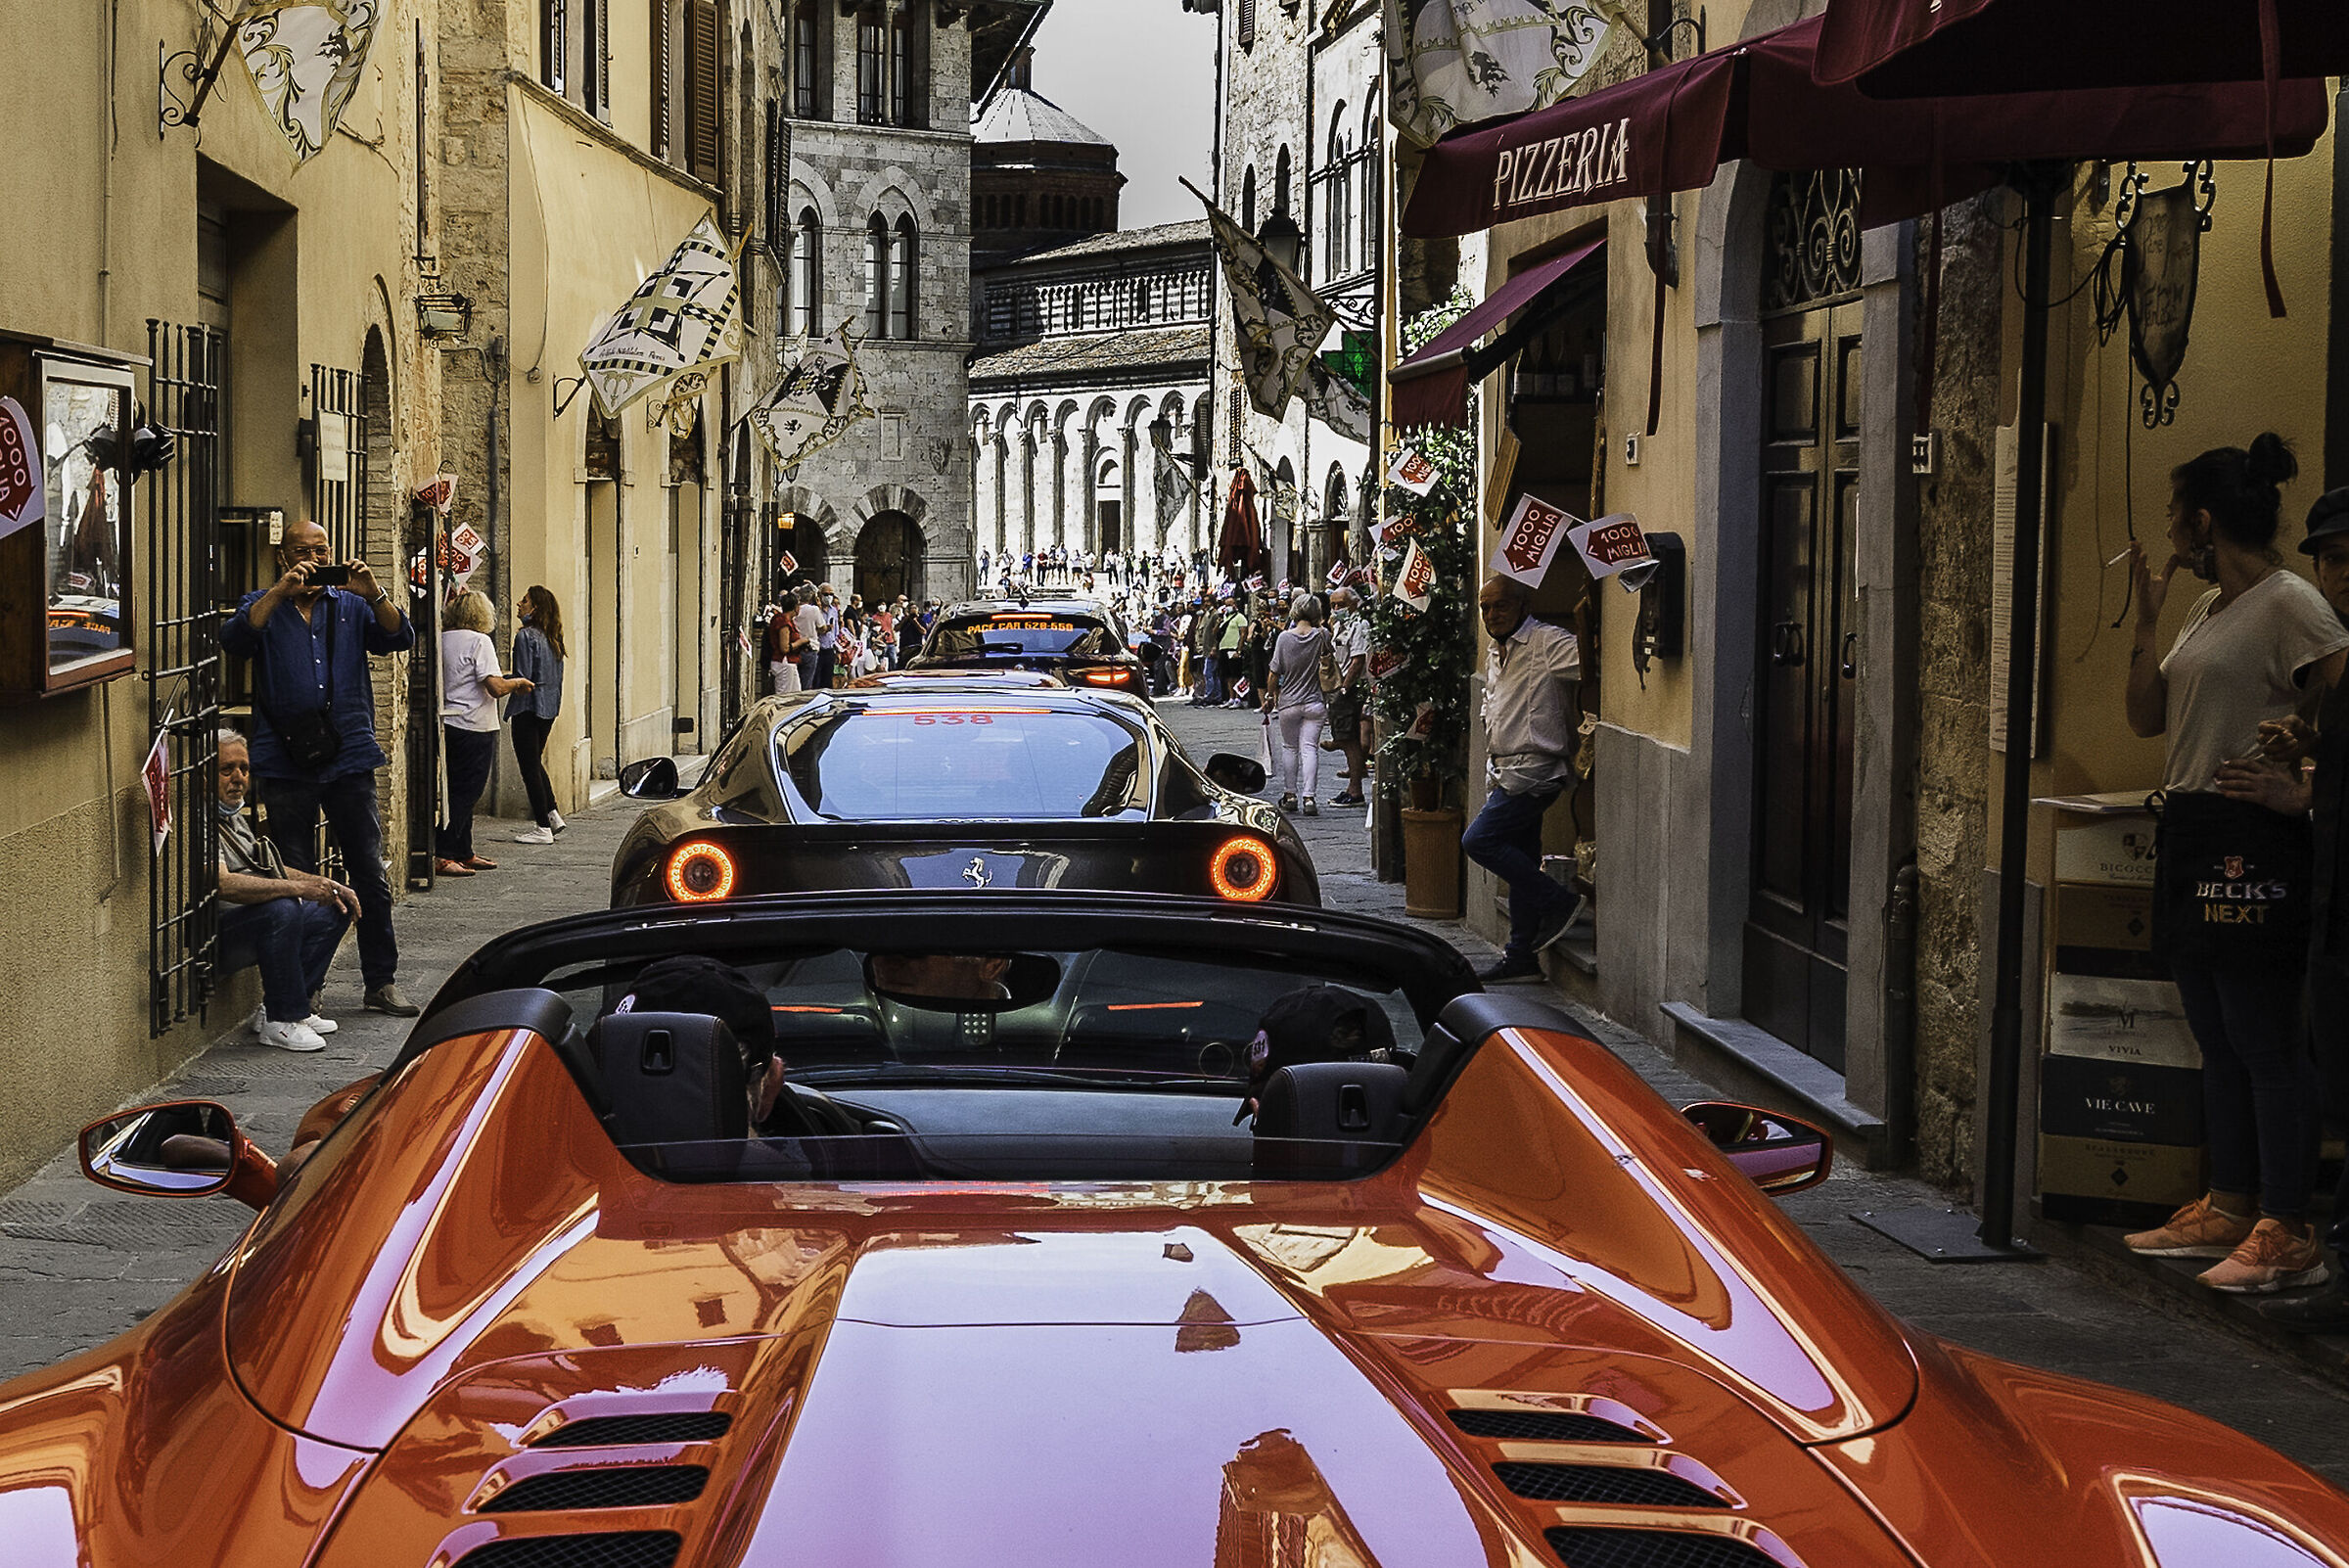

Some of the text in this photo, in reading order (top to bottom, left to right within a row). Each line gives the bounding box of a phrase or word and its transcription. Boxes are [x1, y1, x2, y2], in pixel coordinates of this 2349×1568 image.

[1493, 117, 1631, 210] PIZZERIA
[1513, 509, 1541, 551] 1000
[1527, 513, 1559, 563] MIGLIA
[967, 623, 995, 635] PACE
[998, 622, 1021, 631] CAR
[914, 714, 993, 725] 538
[2204, 902, 2270, 923] NEXT
[2108, 1044, 2142, 1056] VIVIA
[2085, 1097, 2155, 1114] VIE CAVE
